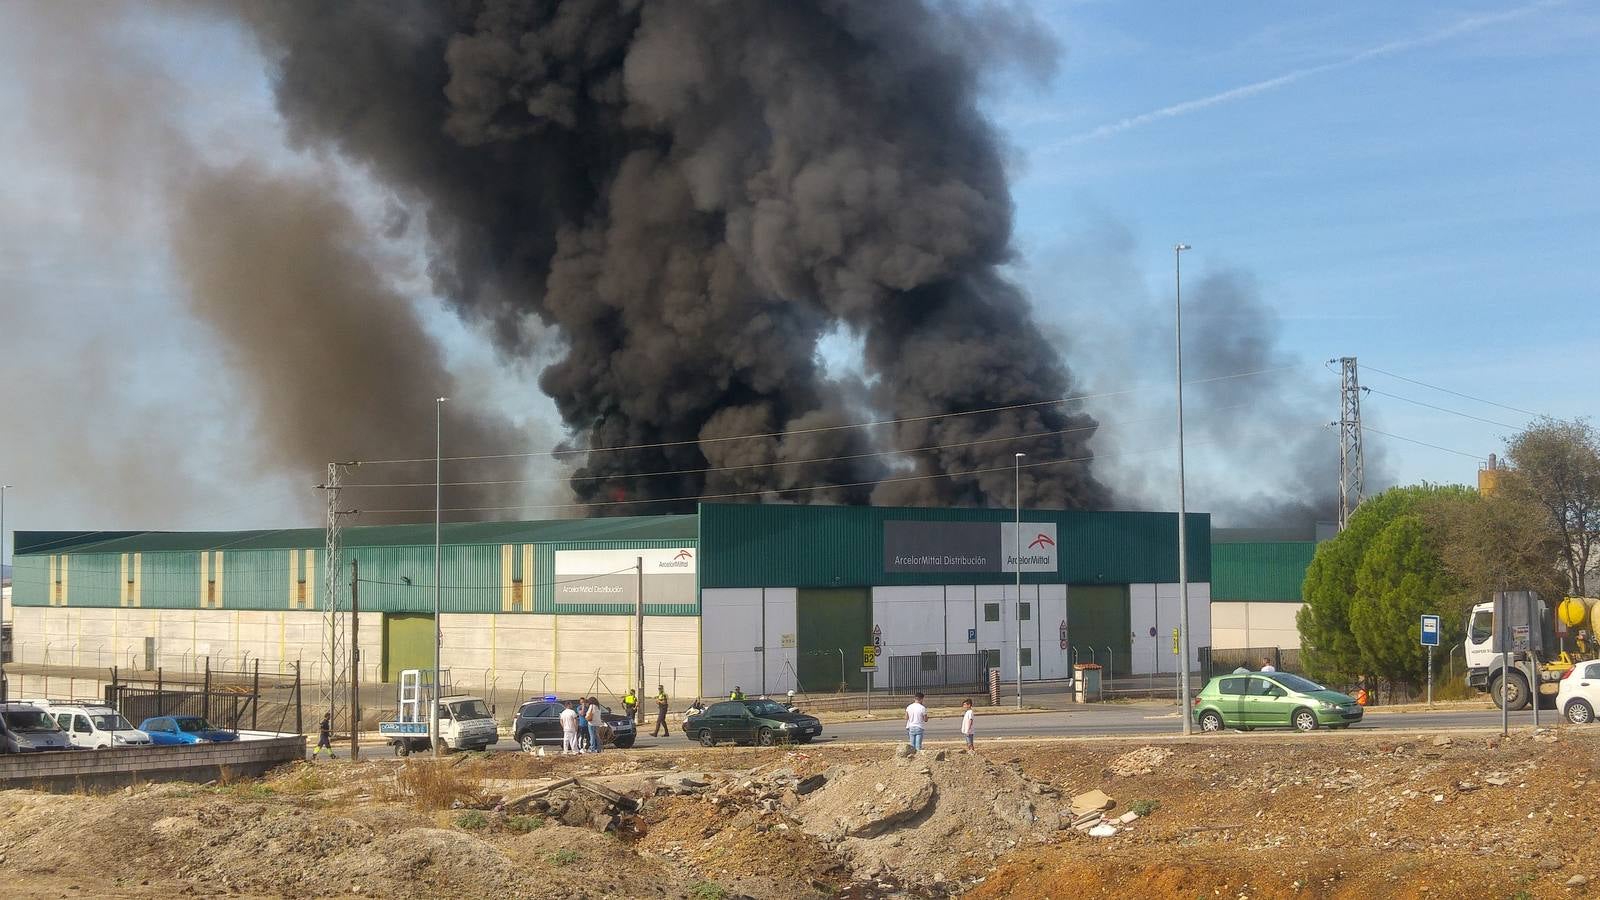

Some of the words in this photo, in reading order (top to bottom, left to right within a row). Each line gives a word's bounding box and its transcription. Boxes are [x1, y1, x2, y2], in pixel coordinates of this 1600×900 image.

[895, 555, 942, 565] ArcelorMittal
[944, 555, 986, 565] Distribución
[1007, 555, 1050, 565] ArcelorMittal
[875, 636, 880, 644] 2
